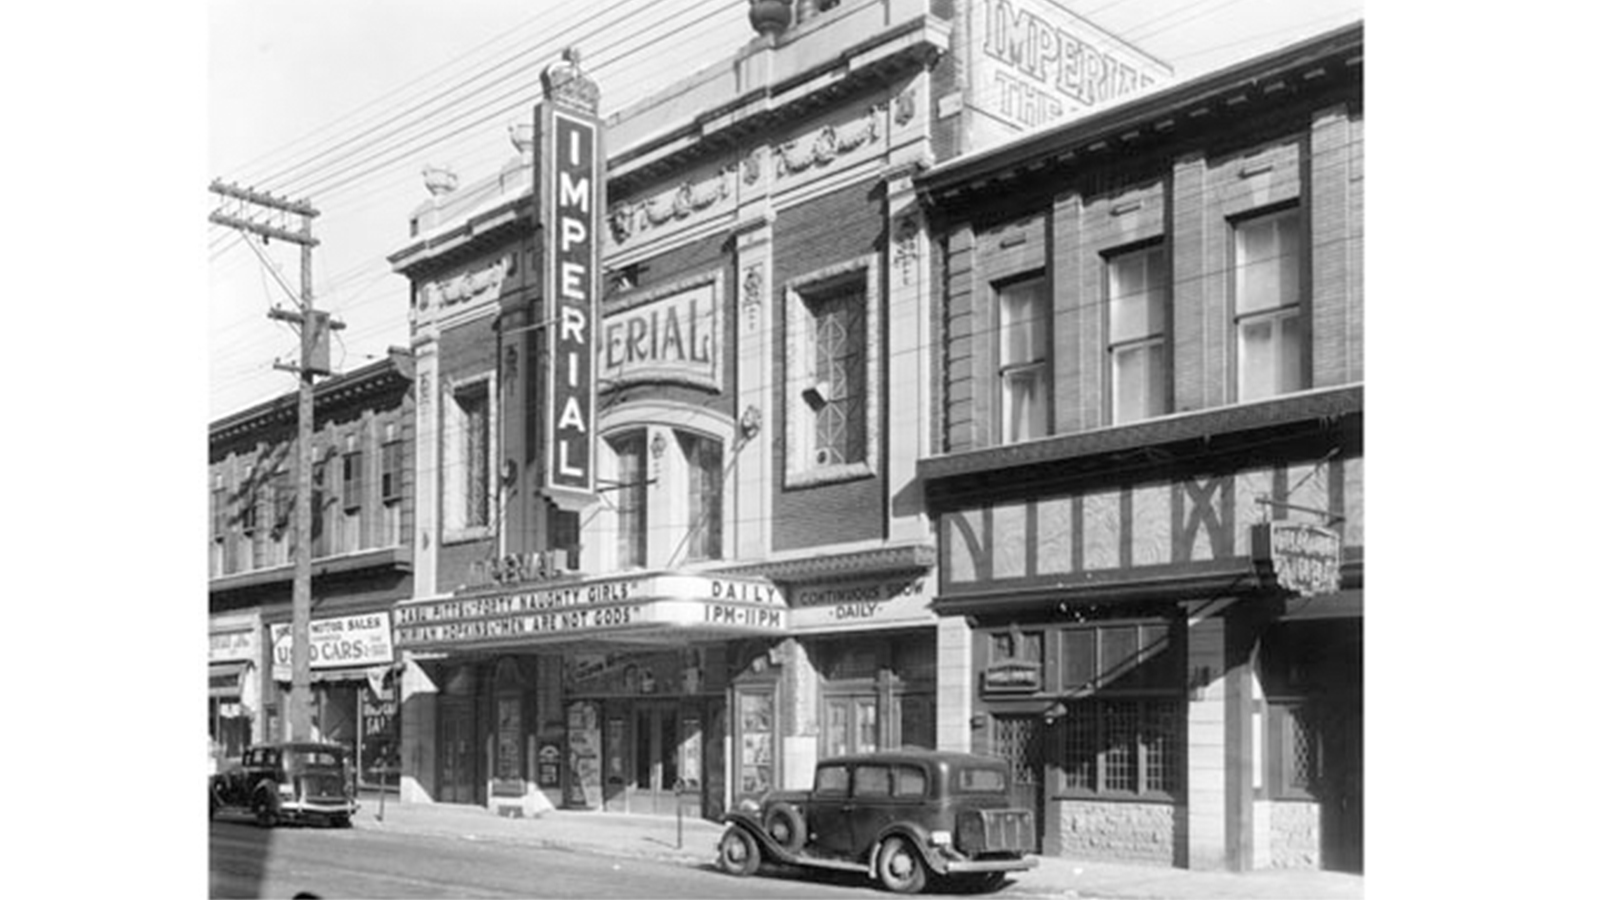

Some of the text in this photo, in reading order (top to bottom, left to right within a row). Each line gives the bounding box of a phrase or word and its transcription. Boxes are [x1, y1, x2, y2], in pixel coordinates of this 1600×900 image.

[558, 129, 589, 477] IMPERIAL
[605, 299, 710, 369] ERIAL
[520, 586, 580, 612] NAUGHTY
[711, 580, 774, 603] DAILY
[800, 579, 926, 606] CONTINUOUS SHOW
[347, 616, 382, 632] SALES
[533, 613, 557, 631] ARE
[562, 610, 588, 629] NOT
[322, 639, 364, 662] CARS
